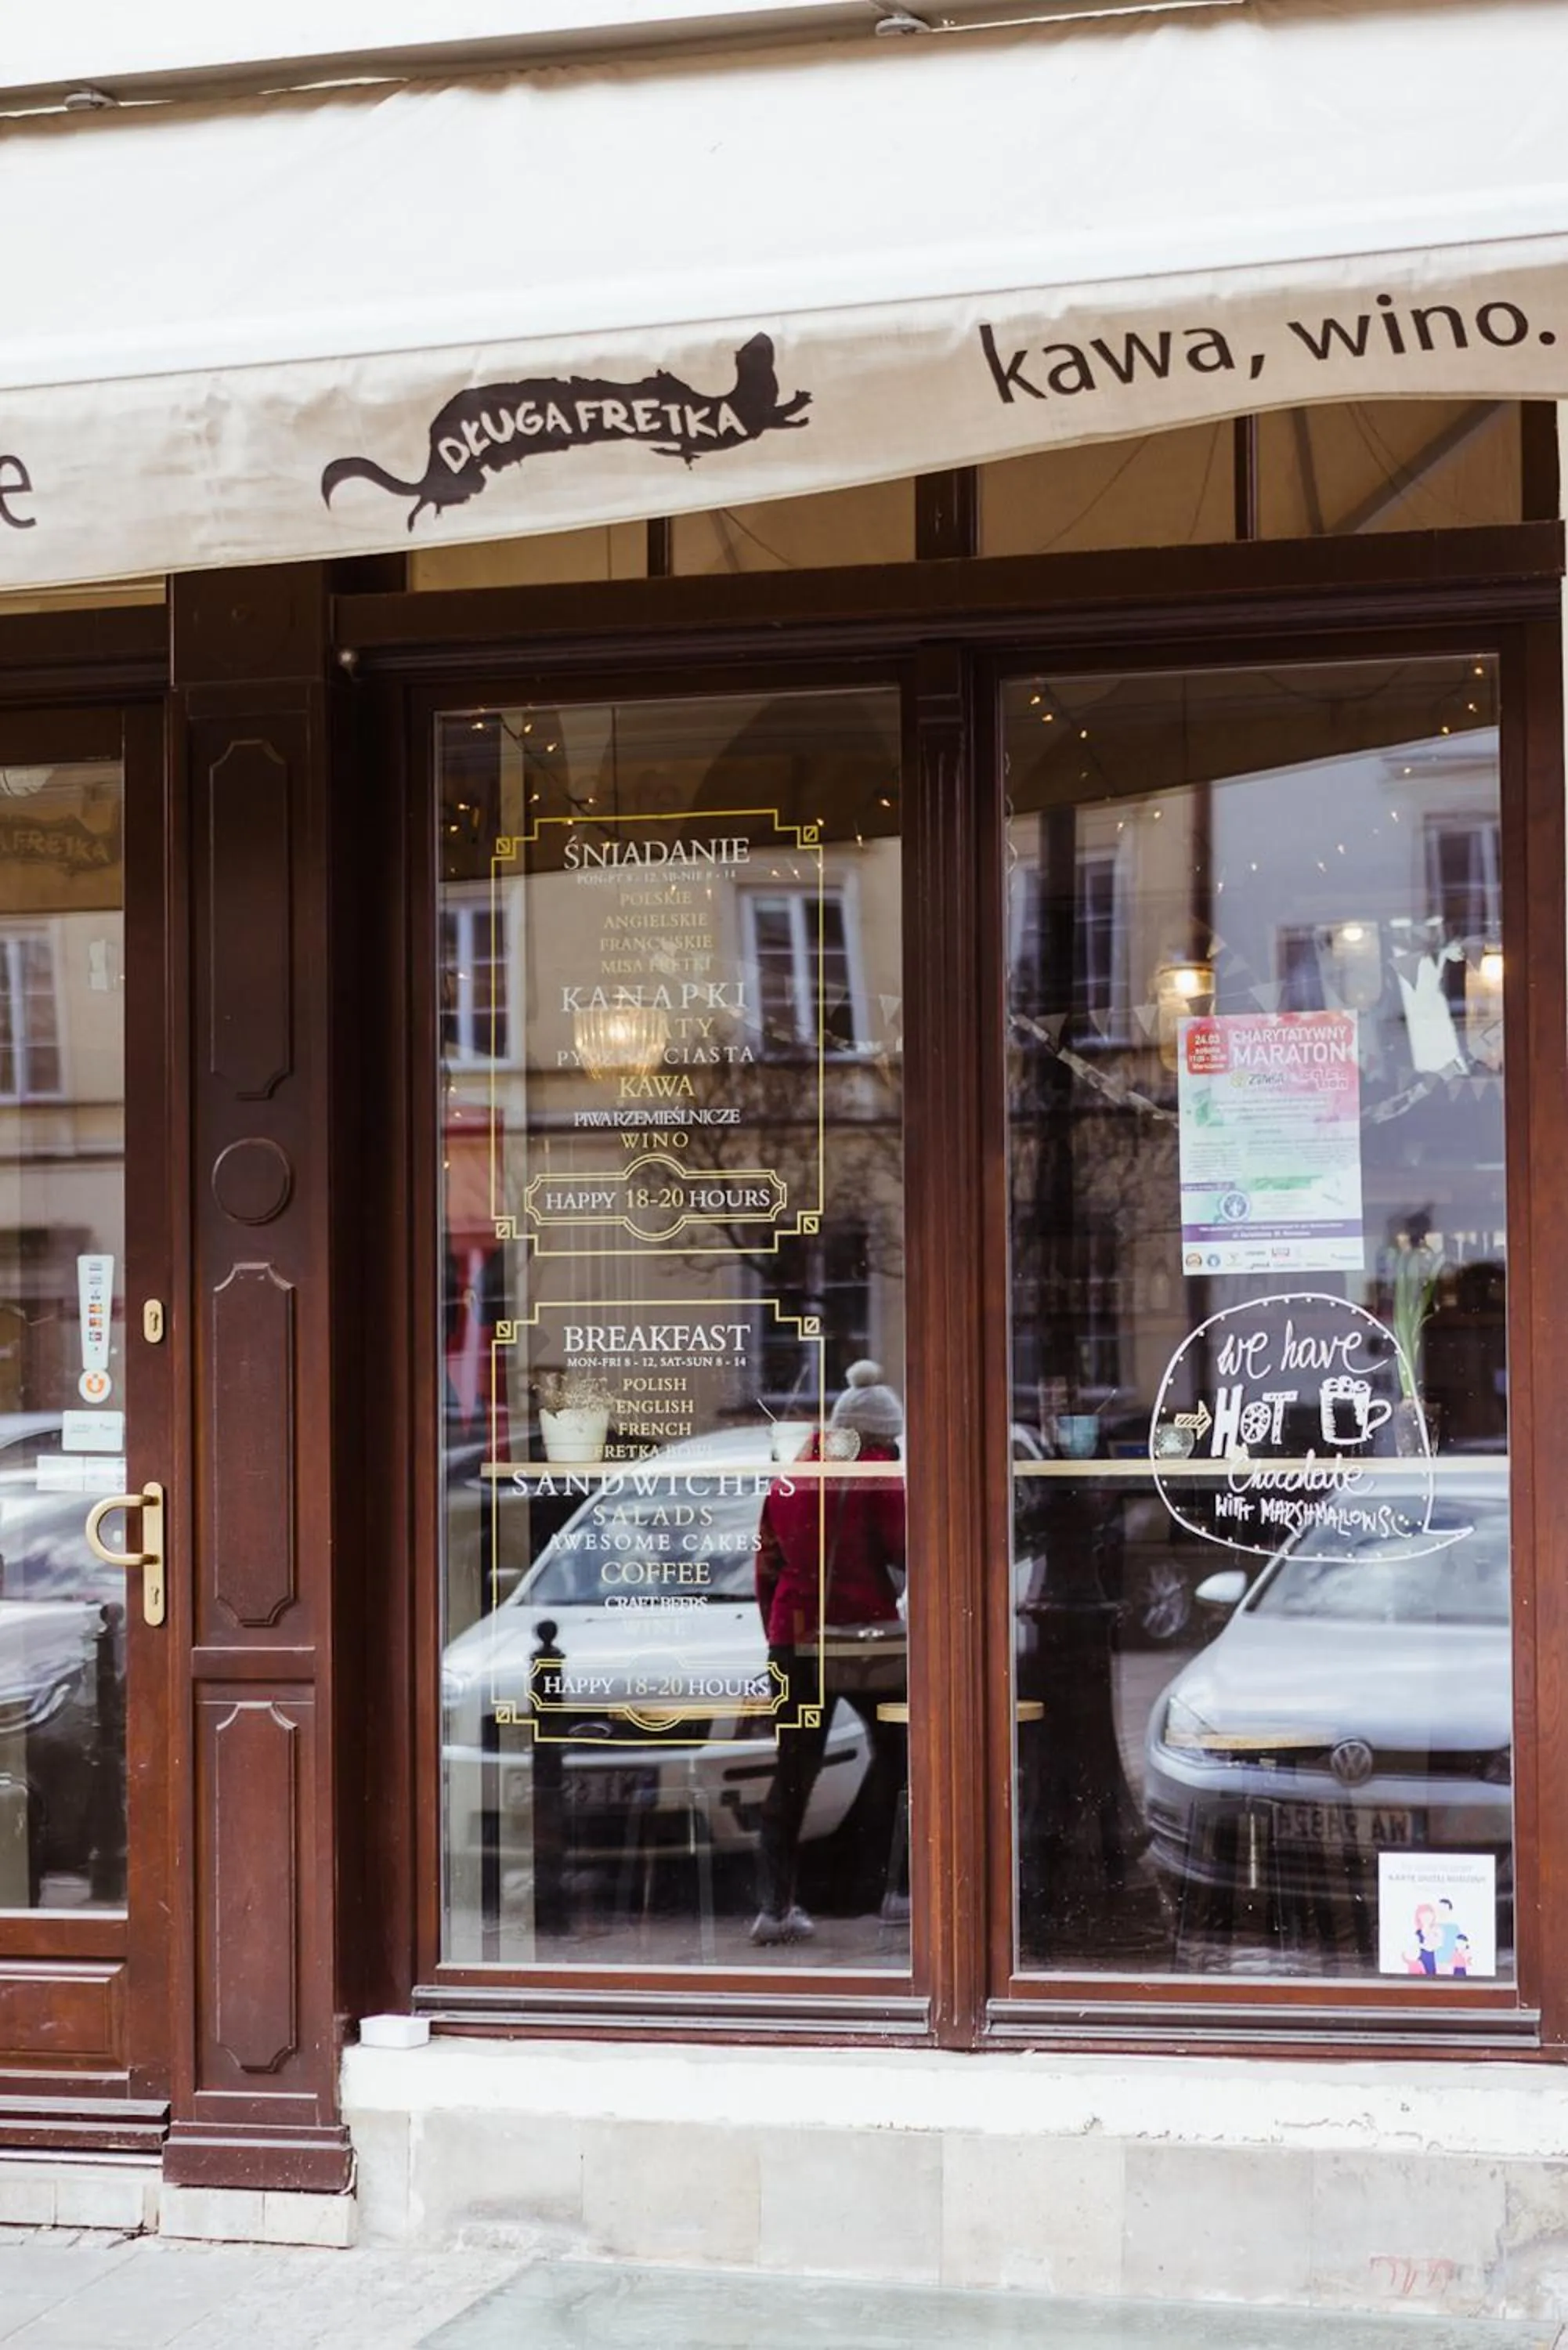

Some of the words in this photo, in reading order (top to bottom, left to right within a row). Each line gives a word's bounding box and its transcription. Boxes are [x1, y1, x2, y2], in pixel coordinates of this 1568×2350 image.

[978, 324, 1265, 403] kawa,
[1288, 294, 1556, 360] wino.
[438, 401, 572, 474] DŁUGA
[574, 399, 747, 438] FRETKA
[564, 835, 750, 870] ŚNIADANIE
[620, 891, 692, 907] POLSKIE
[604, 913, 708, 929] ANGIELSKIE
[601, 959, 642, 974] MISA
[561, 982, 748, 1012] KANAPKI
[1234, 1026, 1347, 1043] CHARYTATYWNY
[664, 1046, 754, 1064] CIASTA
[1233, 1042, 1346, 1066] MARATON
[620, 1075, 695, 1098] KAWA
[621, 1131, 688, 1148] WINO
[546, 1192, 616, 1209] HAPPY
[626, 1188, 684, 1208] 18-20
[689, 1189, 770, 1207] HOURS
[563, 1325, 750, 1353] BREAKFAST
[1281, 1319, 1389, 1373] have
[566, 1358, 620, 1367] MON-FRI
[659, 1357, 713, 1367] SAT-SUN
[734, 1357, 746, 1366] 14
[623, 1377, 687, 1391] POLISH
[616, 1399, 694, 1414] ENGLISH
[618, 1422, 692, 1436] FRENCH
[1211, 1383, 1299, 1458] HOT
[594, 1444, 658, 1459] FRETKA
[511, 1470, 796, 1497] SANDWICHES
[593, 1505, 712, 1526] SALADS
[549, 1534, 670, 1551] AWESOME
[682, 1533, 762, 1551] CAKES
[601, 1562, 710, 1585] COFFEE
[544, 1676, 614, 1694] HAPPY
[627, 1675, 683, 1695] 18-20
[688, 1676, 770, 1697] HOURS
